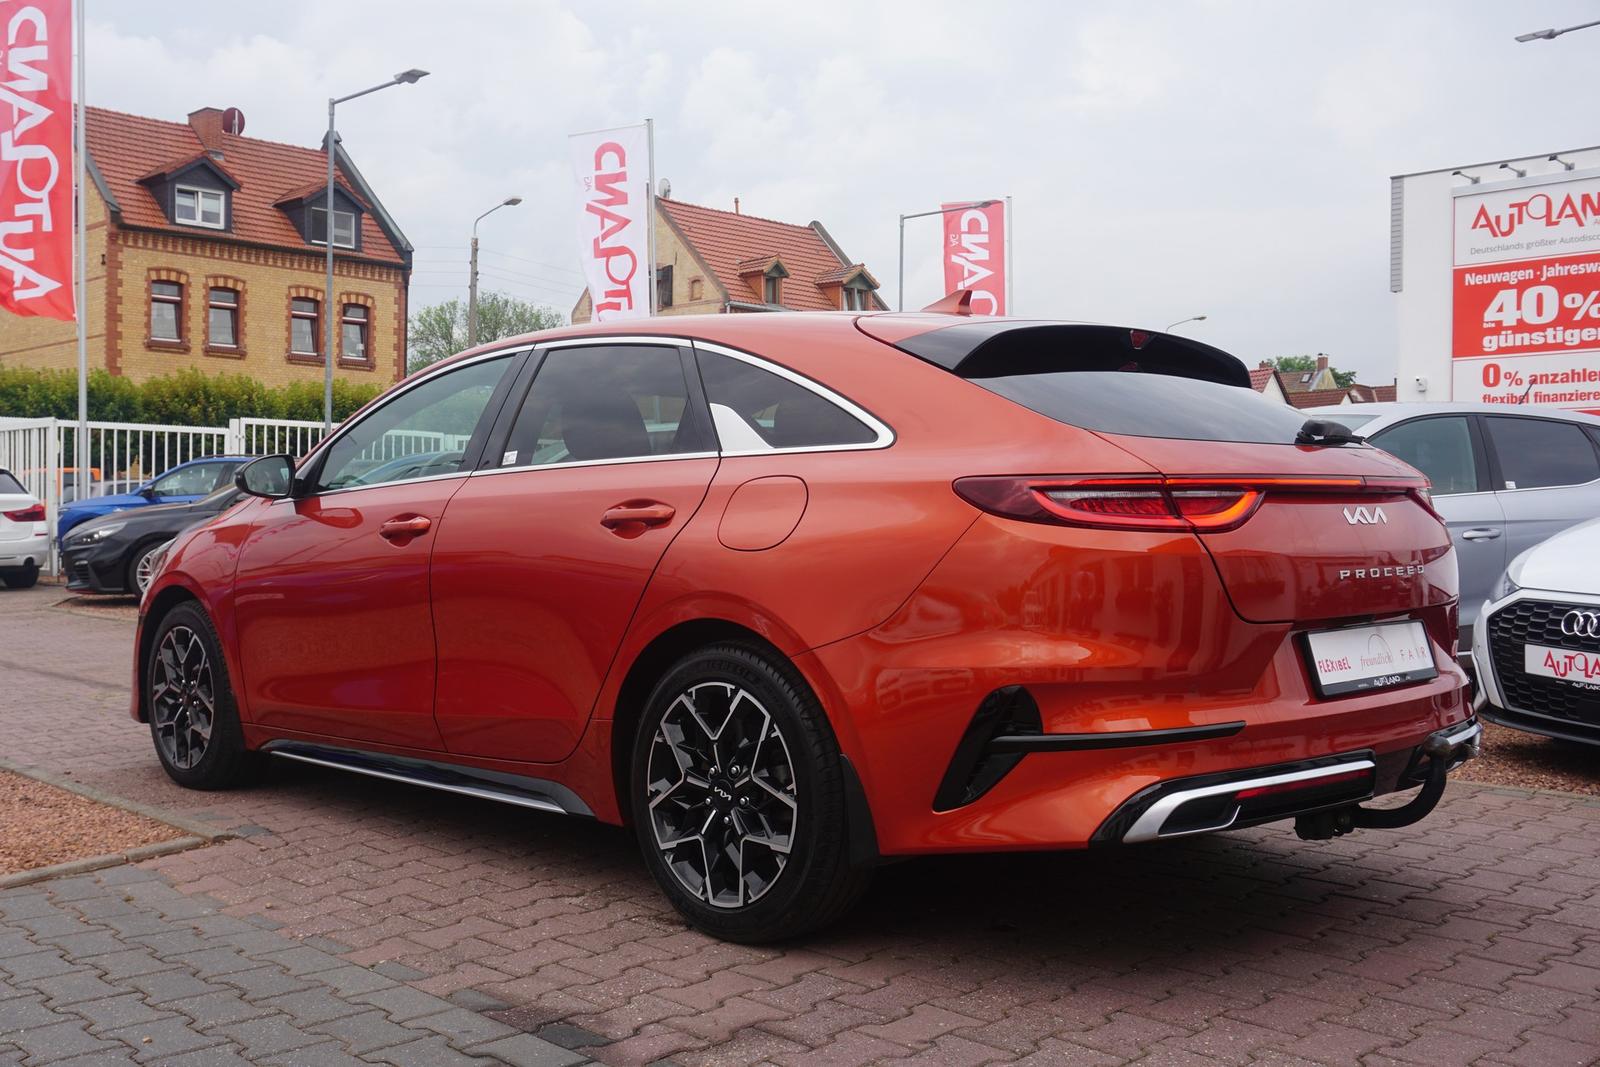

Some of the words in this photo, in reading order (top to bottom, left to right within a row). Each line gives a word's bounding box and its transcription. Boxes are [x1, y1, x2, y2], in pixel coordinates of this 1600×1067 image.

[1470, 242, 1524, 256] Deutschlands
[1526, 237, 1557, 251] größter
[1465, 268, 1533, 286] Neuwagen
[1482, 327, 1600, 352] günstige
[1529, 367, 1600, 385] anzahle
[1482, 392, 1529, 404] flexibel
[1339, 565, 1424, 580] PROCEED
[1318, 656, 1351, 674] FLEXIBEL
